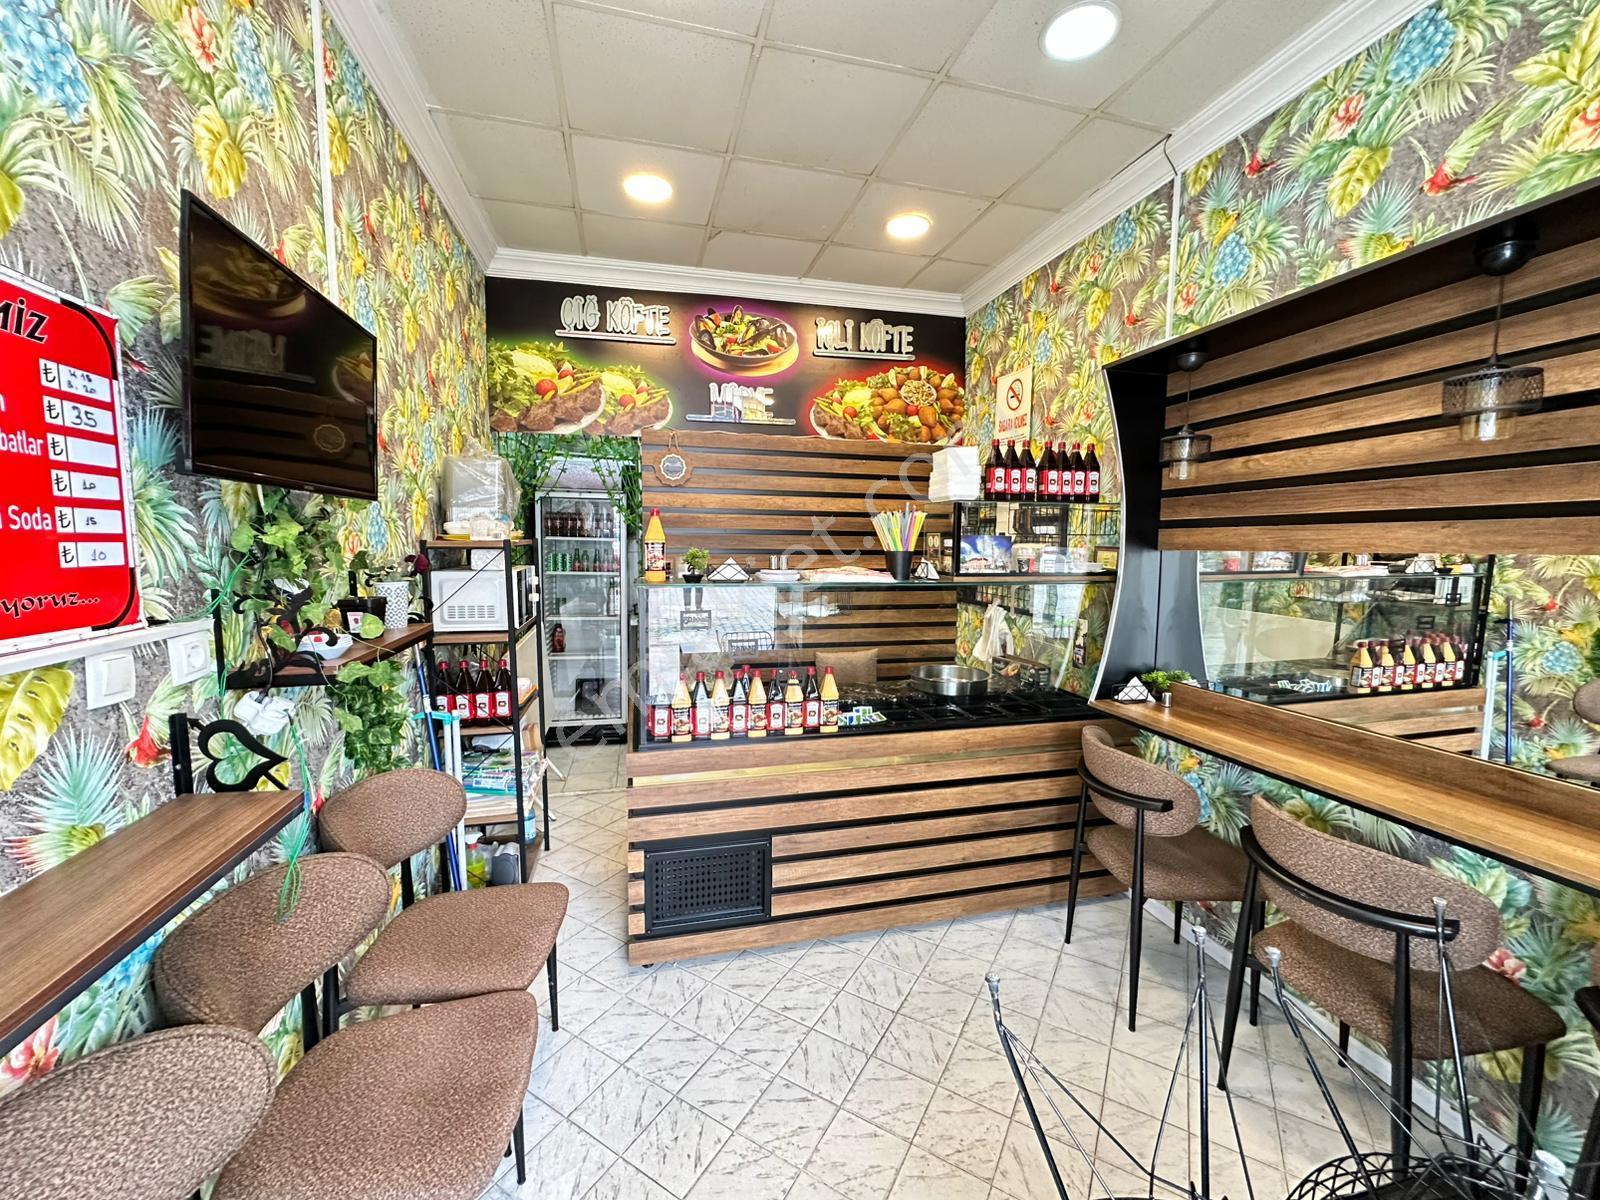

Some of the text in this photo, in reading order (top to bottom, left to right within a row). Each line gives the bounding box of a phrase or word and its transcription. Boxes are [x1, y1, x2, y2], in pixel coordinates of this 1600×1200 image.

[560, 295, 671, 336] ÇİĞ KÖFTE
[860, 319, 914, 354] KÖFTE
[82, 384, 97, 394] 20
[71, 405, 98, 428] 35
[82, 479, 97, 490] 10
[7, 504, 53, 530] Soda
[85, 516, 98, 526] 15
[90, 549, 107, 562] 10
